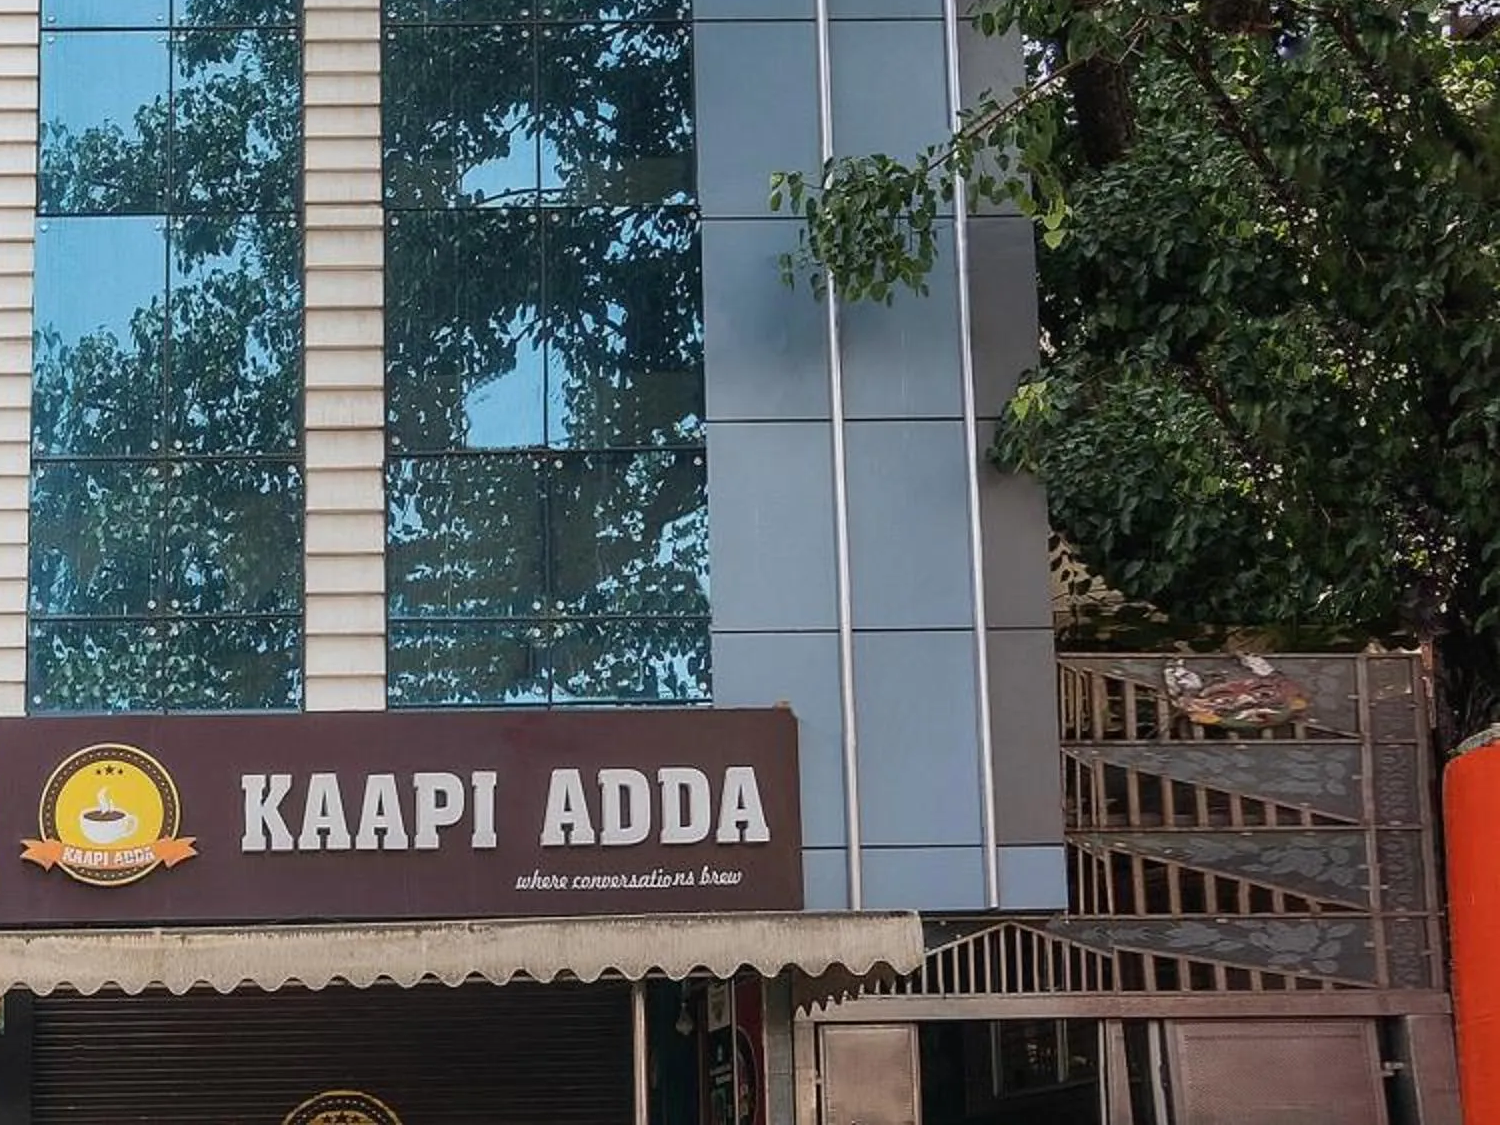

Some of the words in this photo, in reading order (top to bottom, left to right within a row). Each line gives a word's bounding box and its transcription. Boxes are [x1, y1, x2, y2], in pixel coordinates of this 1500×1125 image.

[241, 772, 498, 852] KAAPI
[540, 766, 771, 846] ADDA
[62, 846, 109, 866] KAAPI
[113, 846, 155, 864] ADDA
[515, 869, 568, 890] where
[572, 868, 695, 890] conversations
[699, 865, 743, 886] brew
